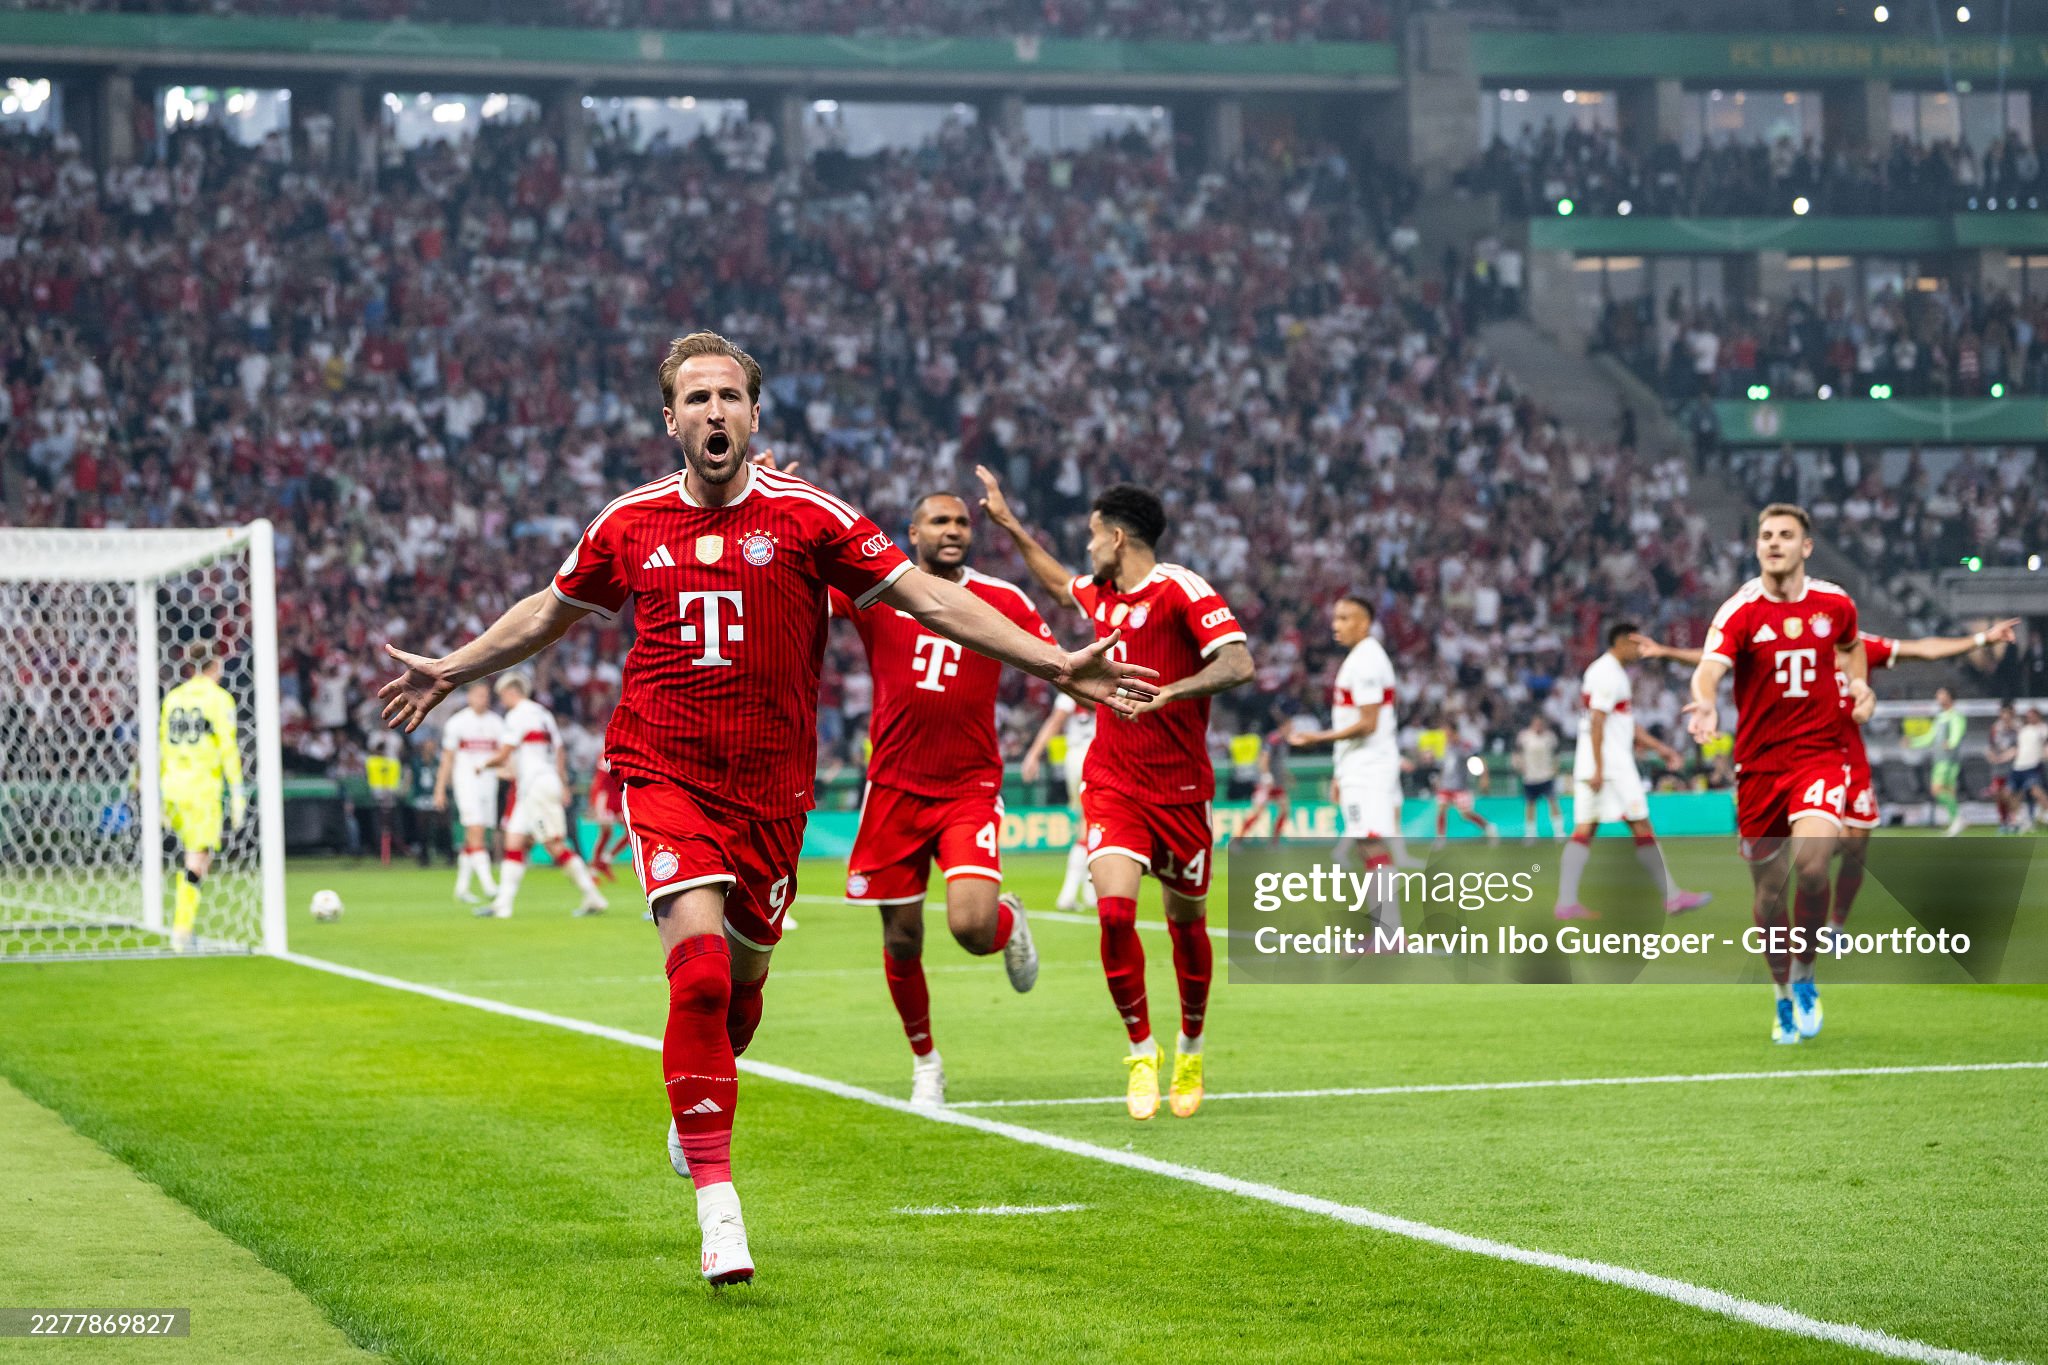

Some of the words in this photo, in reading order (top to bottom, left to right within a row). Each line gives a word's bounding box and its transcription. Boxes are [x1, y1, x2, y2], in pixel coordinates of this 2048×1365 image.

[679, 591, 744, 666] T
[1775, 648, 1816, 698] T
[1803, 779, 1845, 814] 44
[976, 821, 996, 858] 4
[999, 811, 1071, 848] DFB
[1159, 849, 1206, 886] 14
[768, 875, 789, 925] 9
